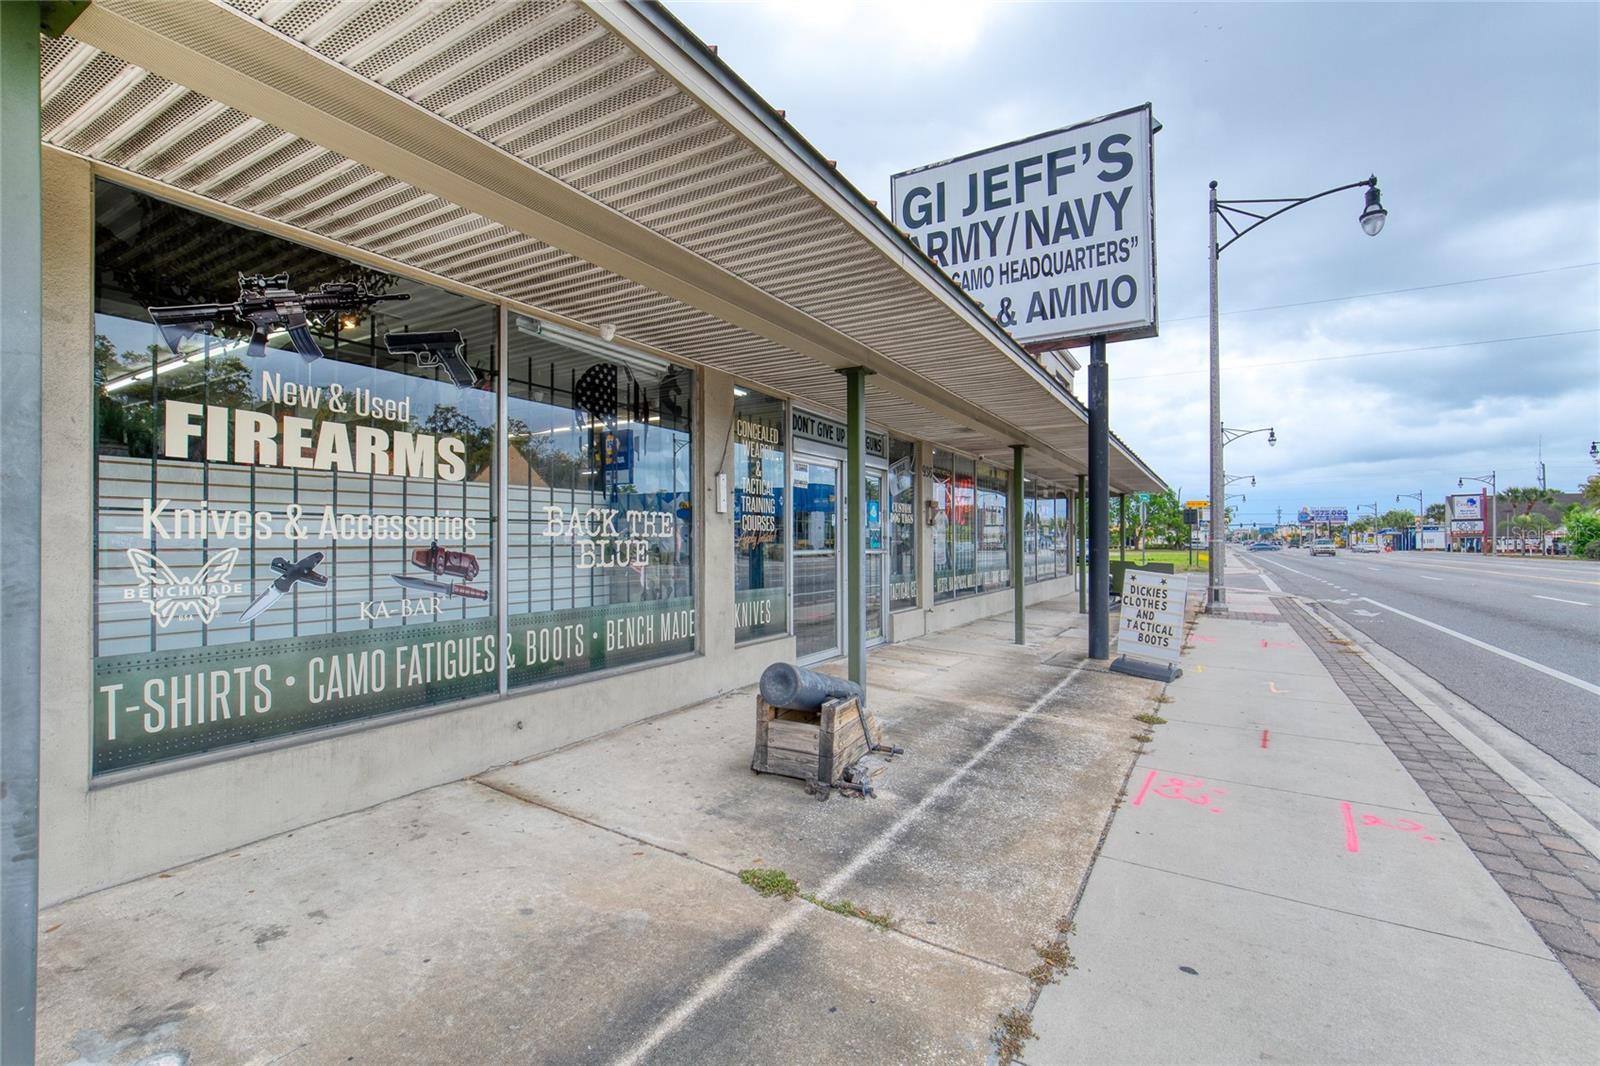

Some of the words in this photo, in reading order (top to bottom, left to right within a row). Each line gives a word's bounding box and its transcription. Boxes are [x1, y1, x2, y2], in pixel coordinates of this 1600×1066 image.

[902, 182, 946, 229] GI
[962, 133, 1134, 217] JEFF'S
[996, 297, 1017, 328] &
[1026, 274, 1138, 324] AMMO
[262, 370, 321, 408] New
[329, 383, 348, 414] &
[355, 387, 410, 423] Used
[164, 399, 467, 482] FIREARMS
[736, 419, 779, 445] CONCEALED
[792, 414, 816, 435] DON'T
[817, 422, 834, 441] GIVE
[836, 427, 846, 443] UP
[743, 441, 776, 460] WEAPON
[755, 460, 763, 477] &
[741, 477, 775, 498] TACTICAL
[740, 495, 776, 515] TRAINING
[142, 498, 273, 540] Knives
[286, 503, 308, 540] &
[319, 506, 477, 541] Accessories
[542, 506, 620, 537] BACK
[626, 511, 674, 538] THE
[741, 514, 776, 533] COURSES
[575, 539, 649, 570] BLUE
[123, 583, 244, 599] BENCHMADE
[1123, 595, 1168, 611] CLOTHES
[1130, 585, 1168, 600] DICKIES
[359, 597, 444, 621] KA-BAR
[735, 599, 771, 628] KNIVES
[1136, 609, 1155, 621] AND
[1126, 619, 1174, 636] TACTICAL
[1137, 632, 1169, 647] BOOTS
[99, 664, 272, 741] T-SHIRTS
[308, 648, 386, 704] CAMO
[396, 634, 496, 689] FATIGUES
[526, 624, 585, 665] BOOTS
[606, 614, 654, 652] BENCH
[660, 608, 695, 641] MADE
